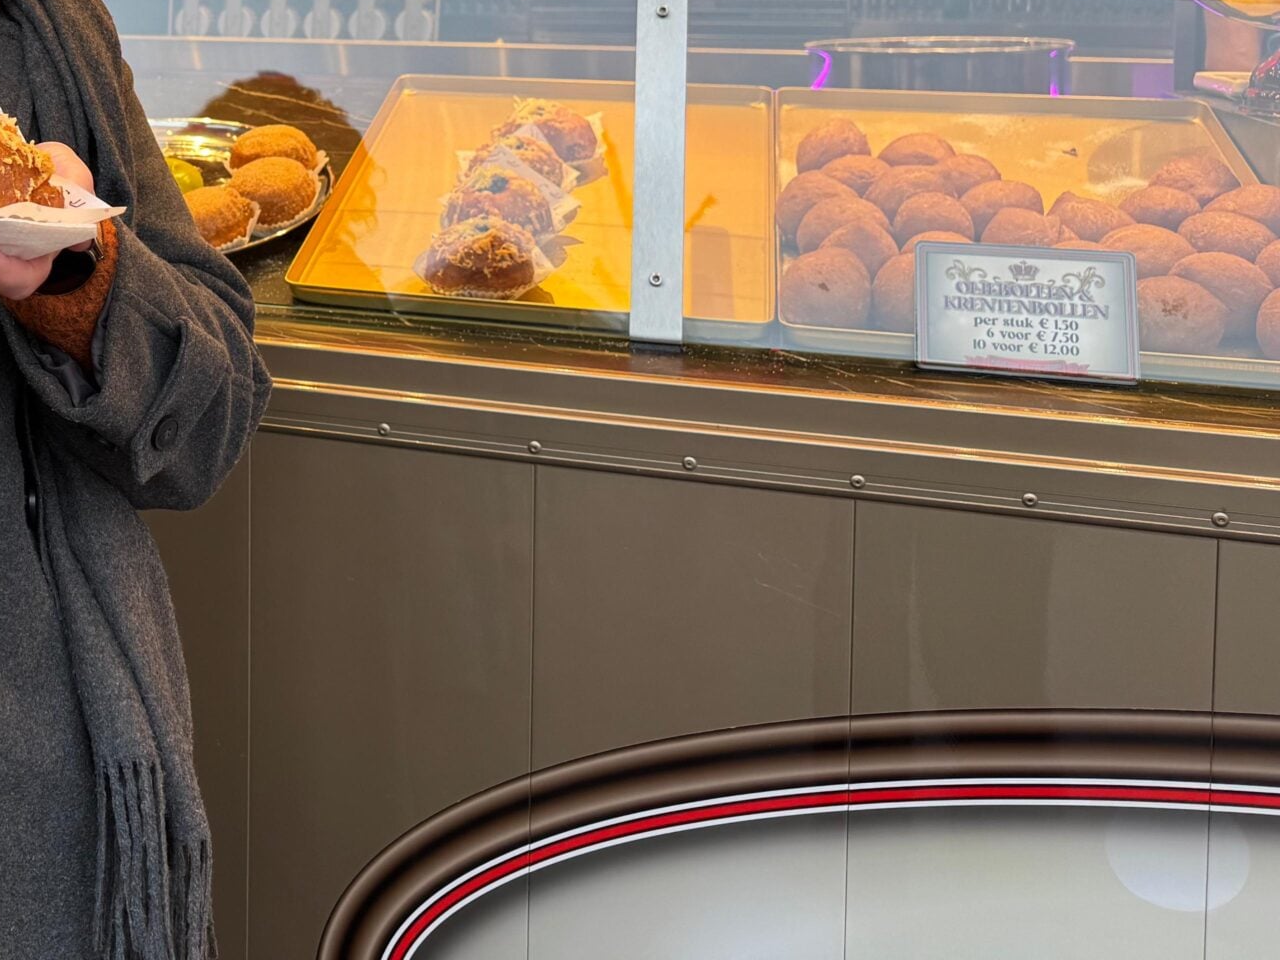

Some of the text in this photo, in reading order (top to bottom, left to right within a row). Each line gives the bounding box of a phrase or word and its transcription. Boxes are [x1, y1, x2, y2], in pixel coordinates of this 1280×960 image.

[955, 280, 1096, 303] OLIEBOLLEN &
[943, 295, 1110, 321] KRENTENBOLLEN
[973, 316, 1079, 332] per stuk € 1.50
[986, 327, 1080, 344] 6 voor € 7.50
[972, 339, 1080, 356] 10 voor € 12.00
